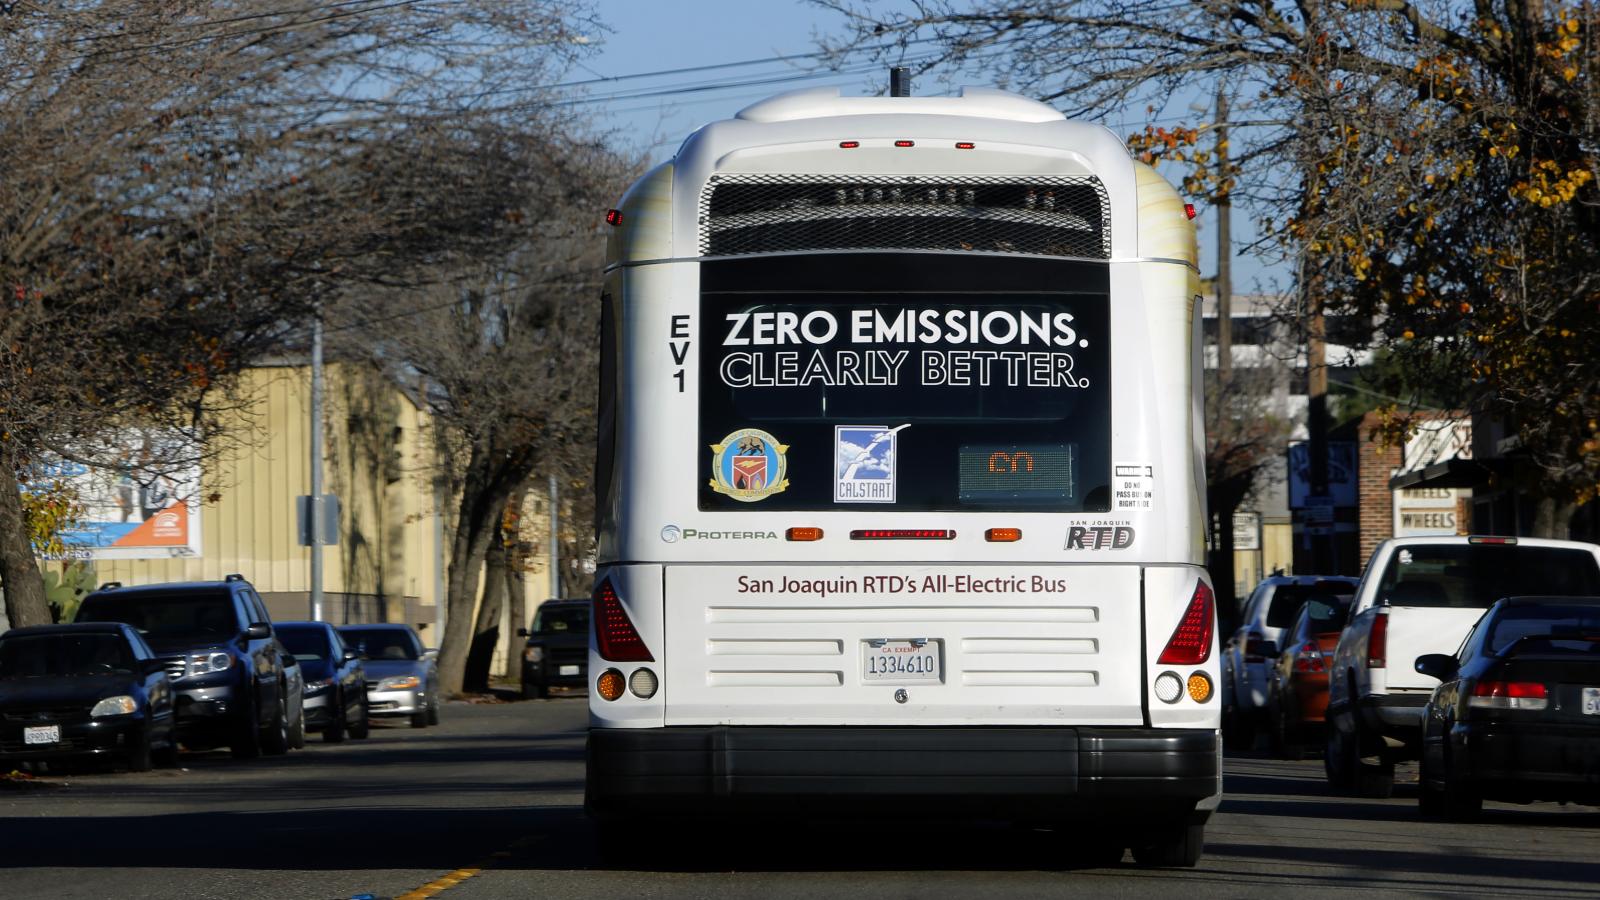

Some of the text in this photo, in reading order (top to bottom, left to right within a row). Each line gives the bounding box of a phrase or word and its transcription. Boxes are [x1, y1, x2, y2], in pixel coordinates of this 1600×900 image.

[722, 308, 1090, 348] ZERO EMISSIONS.
[669, 315, 691, 392] EV1
[720, 349, 1090, 388] CLEARLY BETTER.
[839, 482, 891, 498] CALSTART
[1401, 513, 1455, 529] WHEELS
[682, 528, 777, 540] PROTERRA
[1064, 526, 1136, 550] RTD
[738, 576, 773, 593] San
[778, 576, 857, 597] Joaquin
[922, 575, 1026, 593] All-Electric
[1031, 576, 1066, 593] Bus
[869, 655, 934, 673] 1334610
